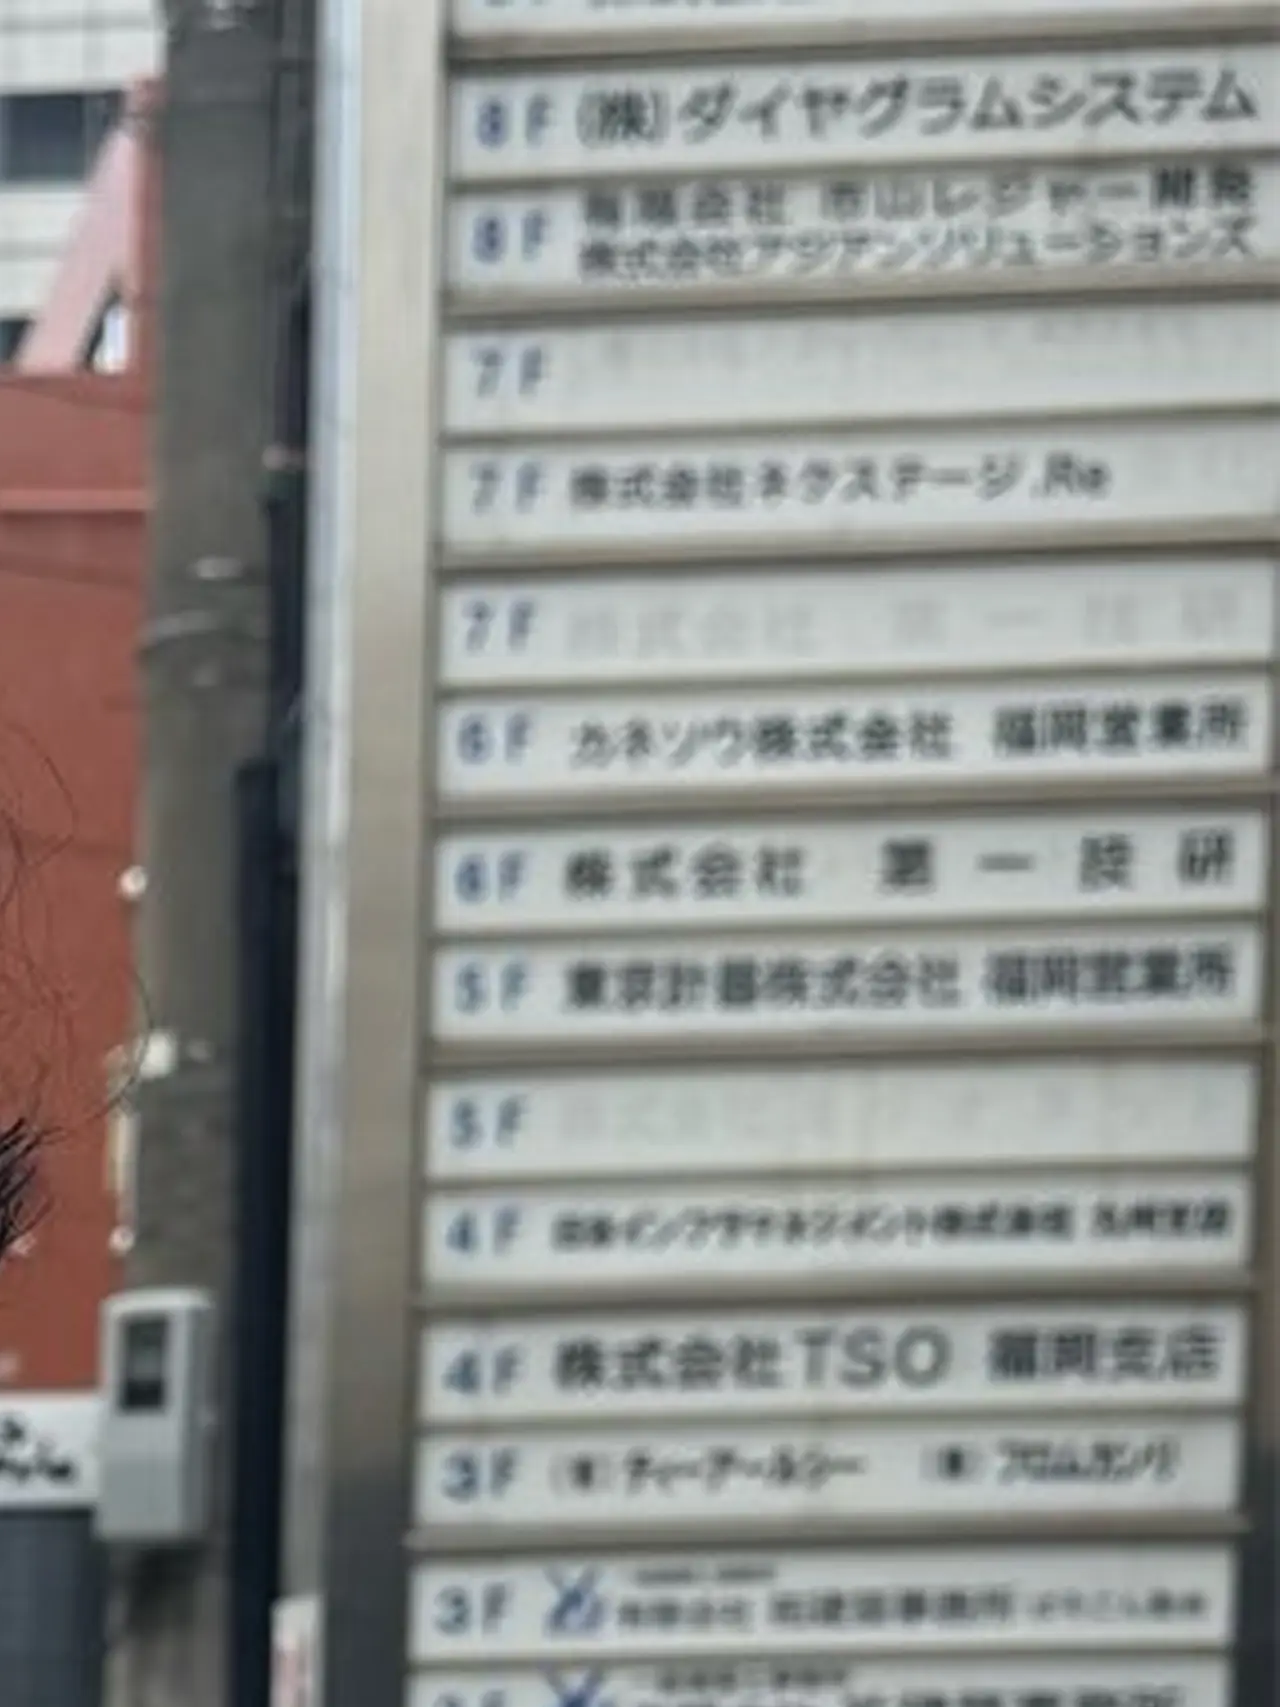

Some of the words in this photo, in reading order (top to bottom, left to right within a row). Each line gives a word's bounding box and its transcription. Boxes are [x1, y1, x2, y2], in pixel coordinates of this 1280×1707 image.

[993, 698, 1248, 756] 福岡営業所
[564, 844, 804, 898] 株式会社
[444, 1348, 520, 1396] 4F
[554, 1328, 954, 1390] 株式会社TSO
[987, 1324, 1220, 1382] 福岡支店
[439, 1450, 518, 1502] 3F
[436, 1584, 510, 1636] 3F
